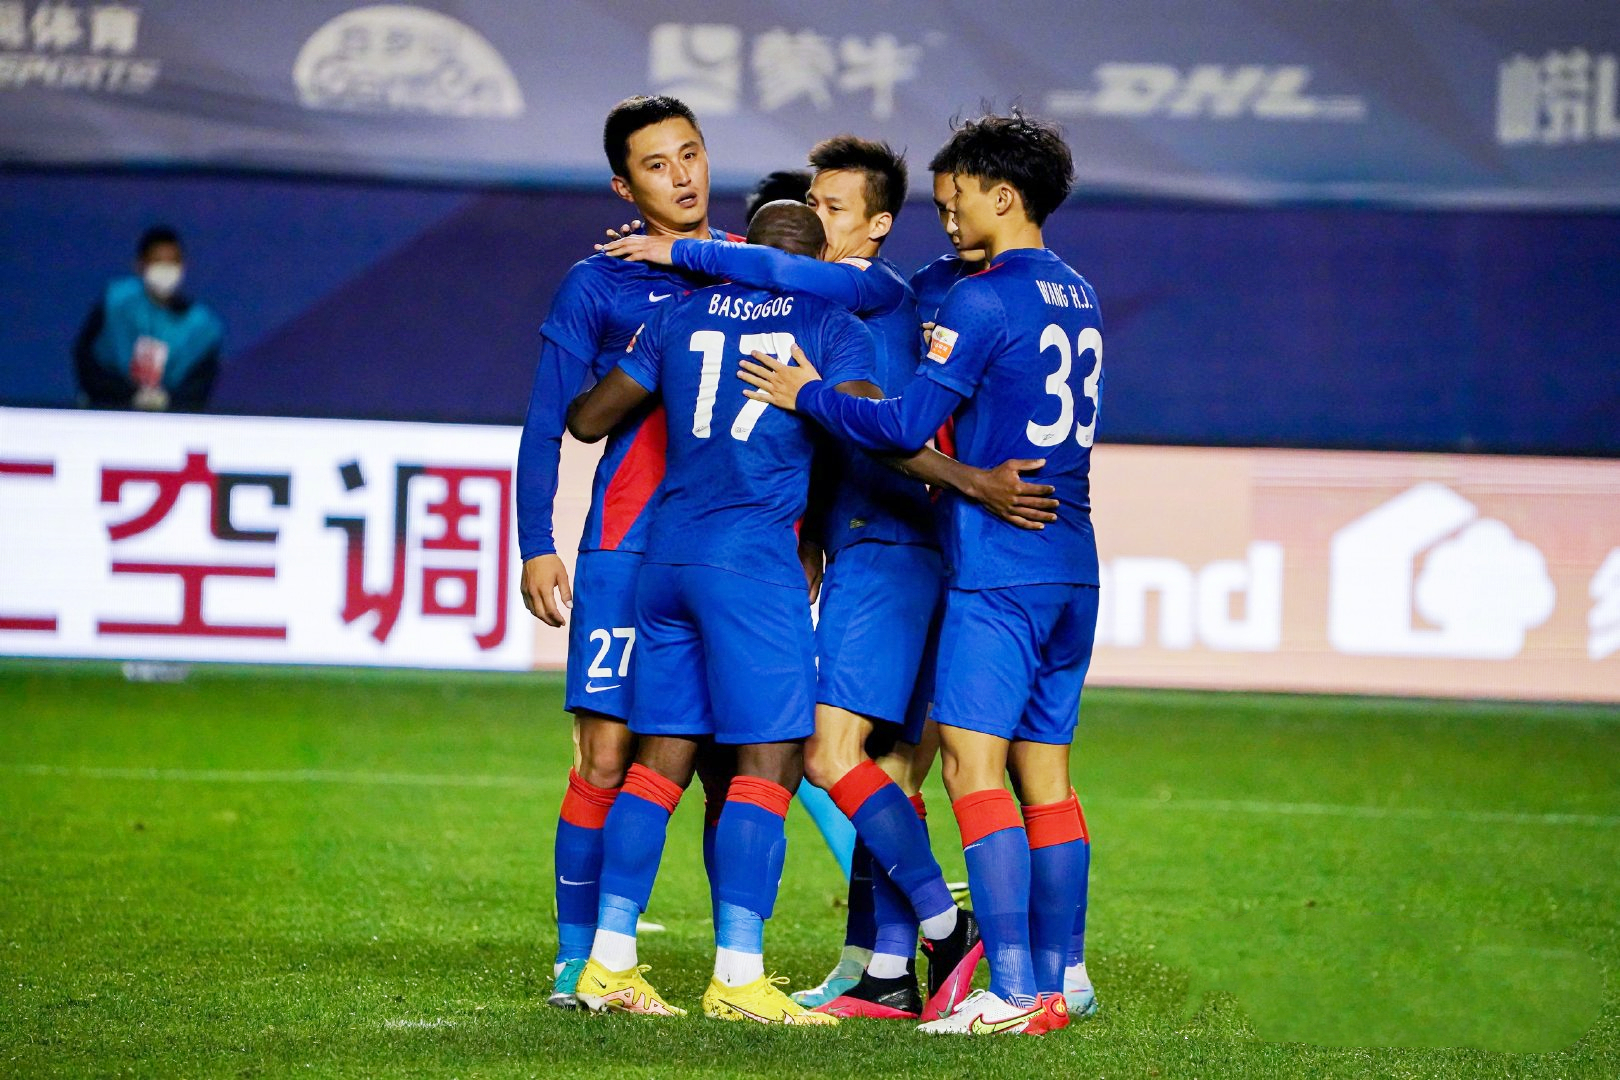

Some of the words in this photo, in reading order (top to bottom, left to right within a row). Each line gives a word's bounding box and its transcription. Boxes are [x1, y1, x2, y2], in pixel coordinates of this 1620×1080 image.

[1094, 62, 1312, 119] DHL
[708, 293, 794, 321] BASSOGOG
[1035, 279, 1069, 308] WANG
[689, 330, 797, 442] 17
[1026, 323, 1103, 448] 33
[587, 627, 636, 678] 27
